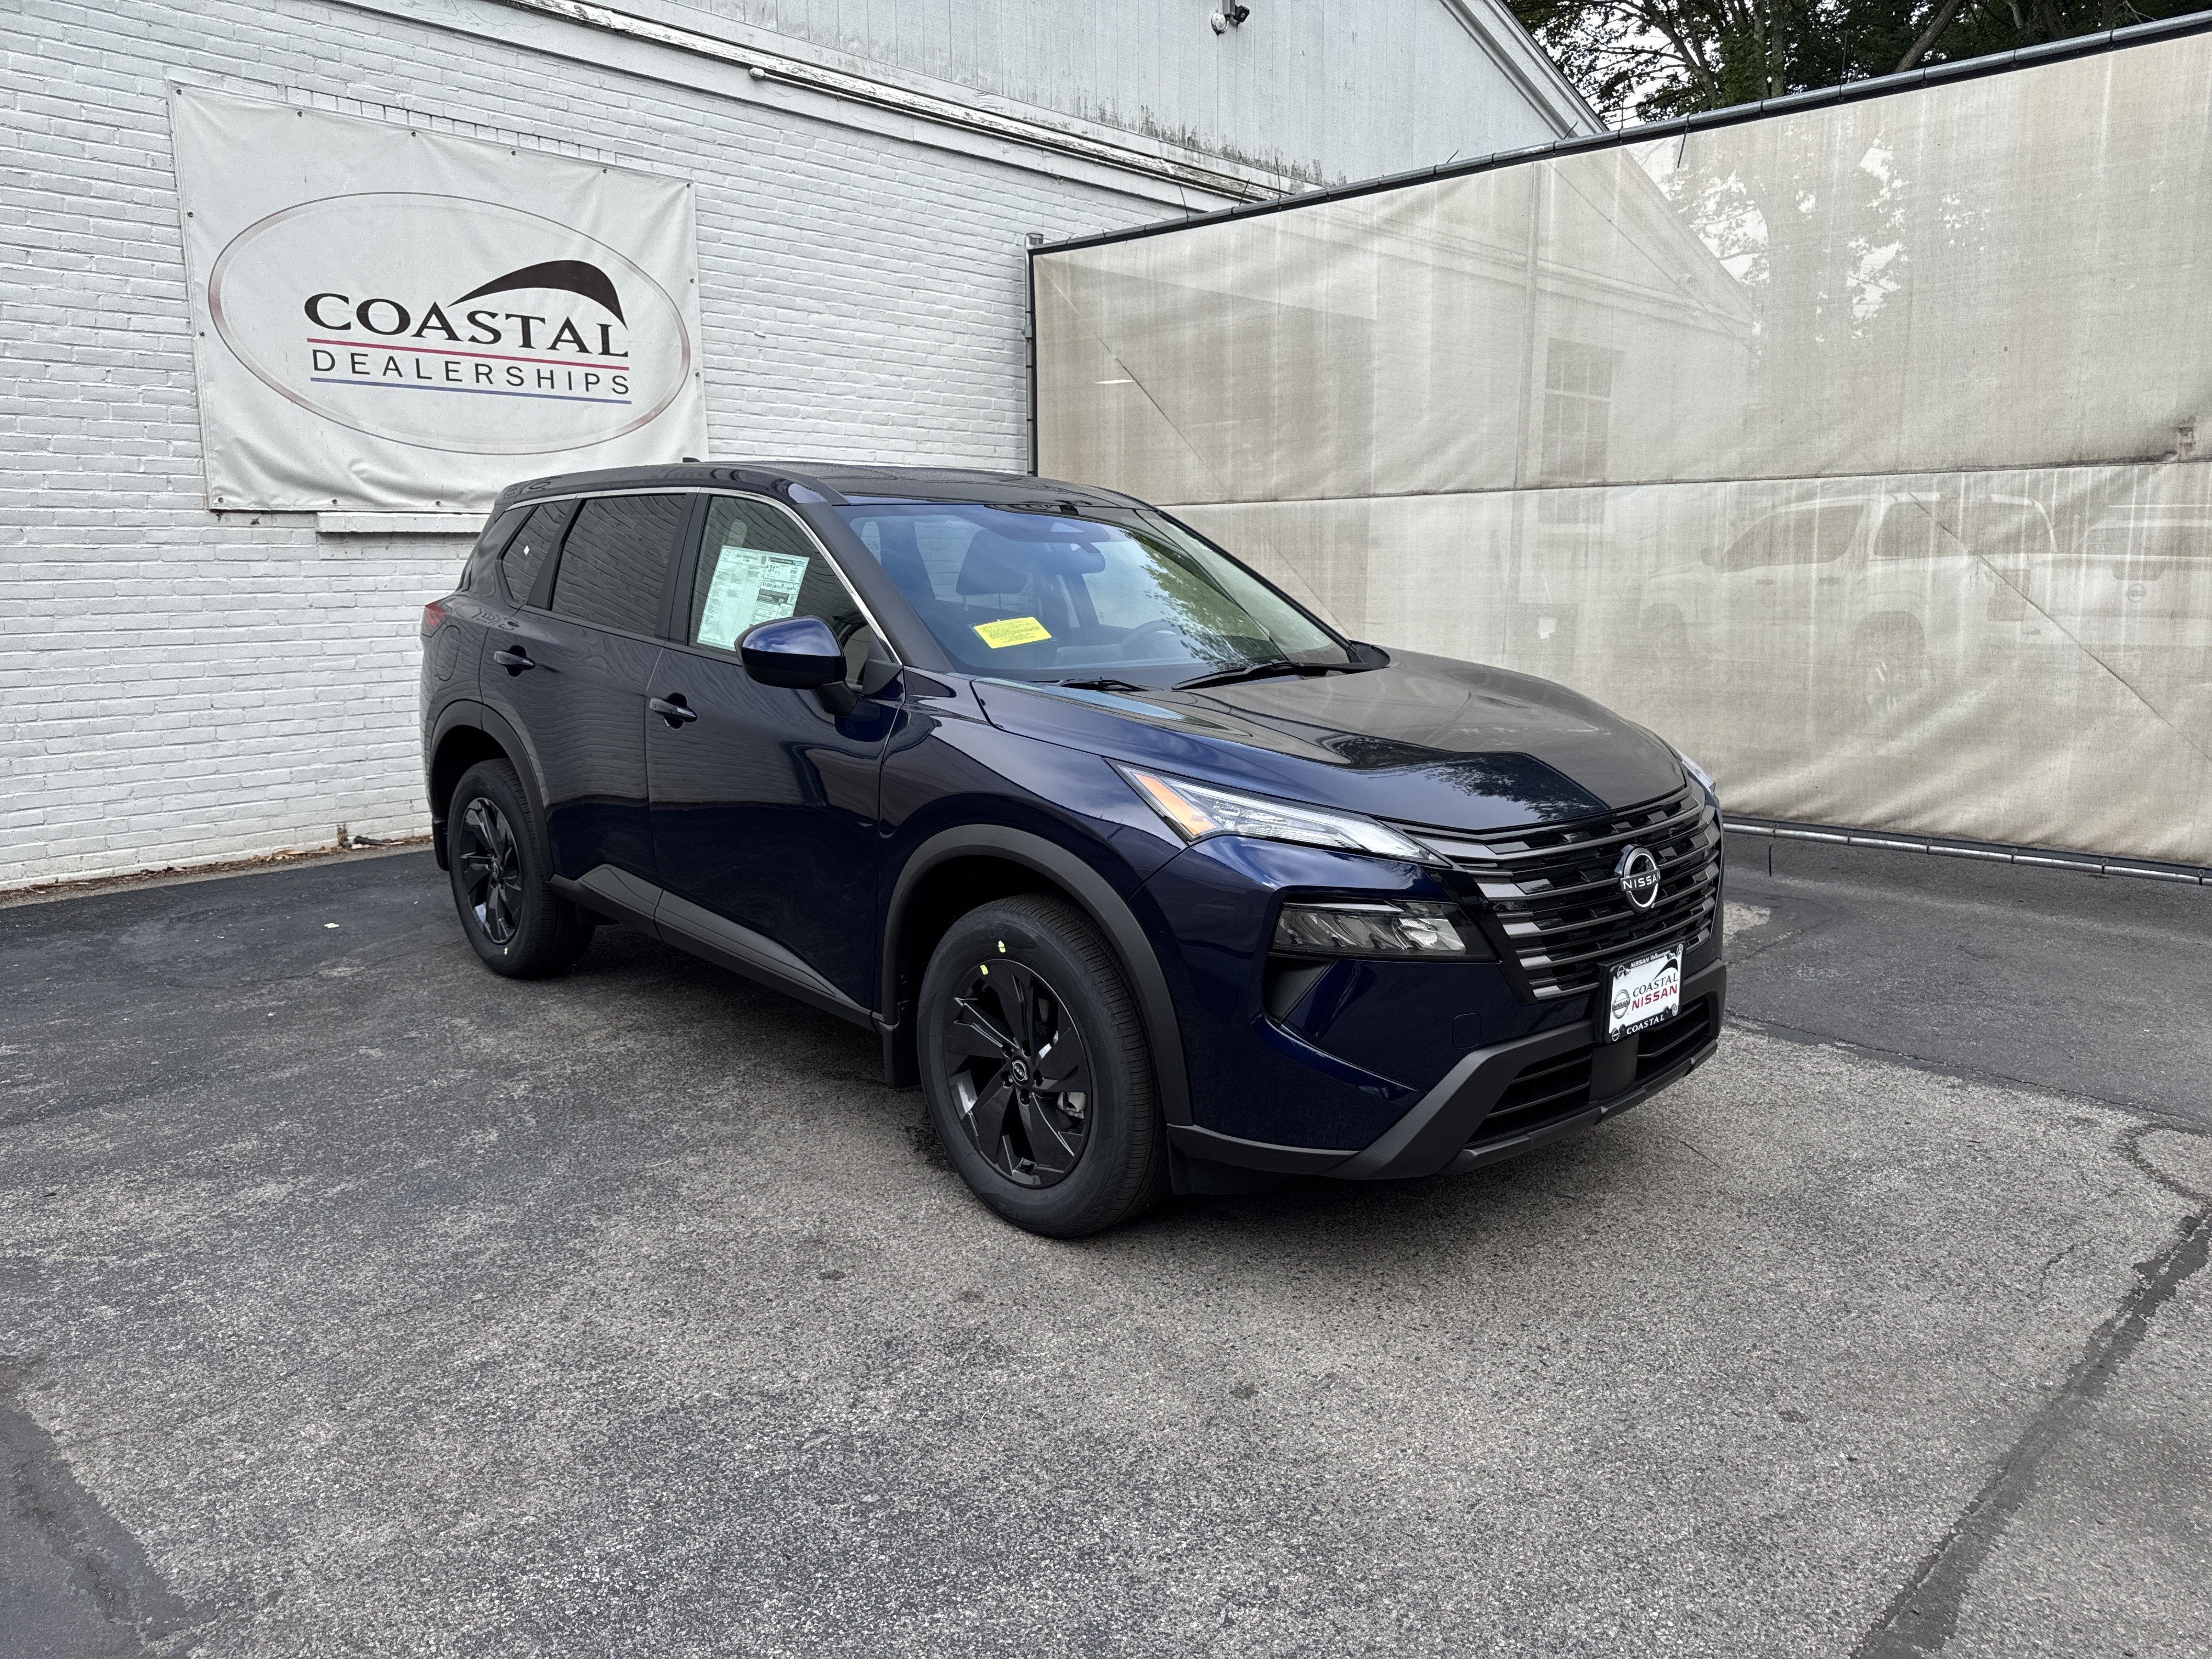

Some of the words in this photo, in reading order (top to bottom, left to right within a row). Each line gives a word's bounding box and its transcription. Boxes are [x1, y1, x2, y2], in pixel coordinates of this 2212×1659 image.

[304, 293, 629, 358] COASTAL
[312, 349, 629, 395] DEALERSHIPS
[1623, 872, 1661, 890] NISSAN
[1630, 957, 1650, 968] NISSAN
[1633, 973, 1678, 997] COASTAL
[1632, 984, 1678, 1011] NISSAN
[1626, 1014, 1665, 1035] COASTAL
